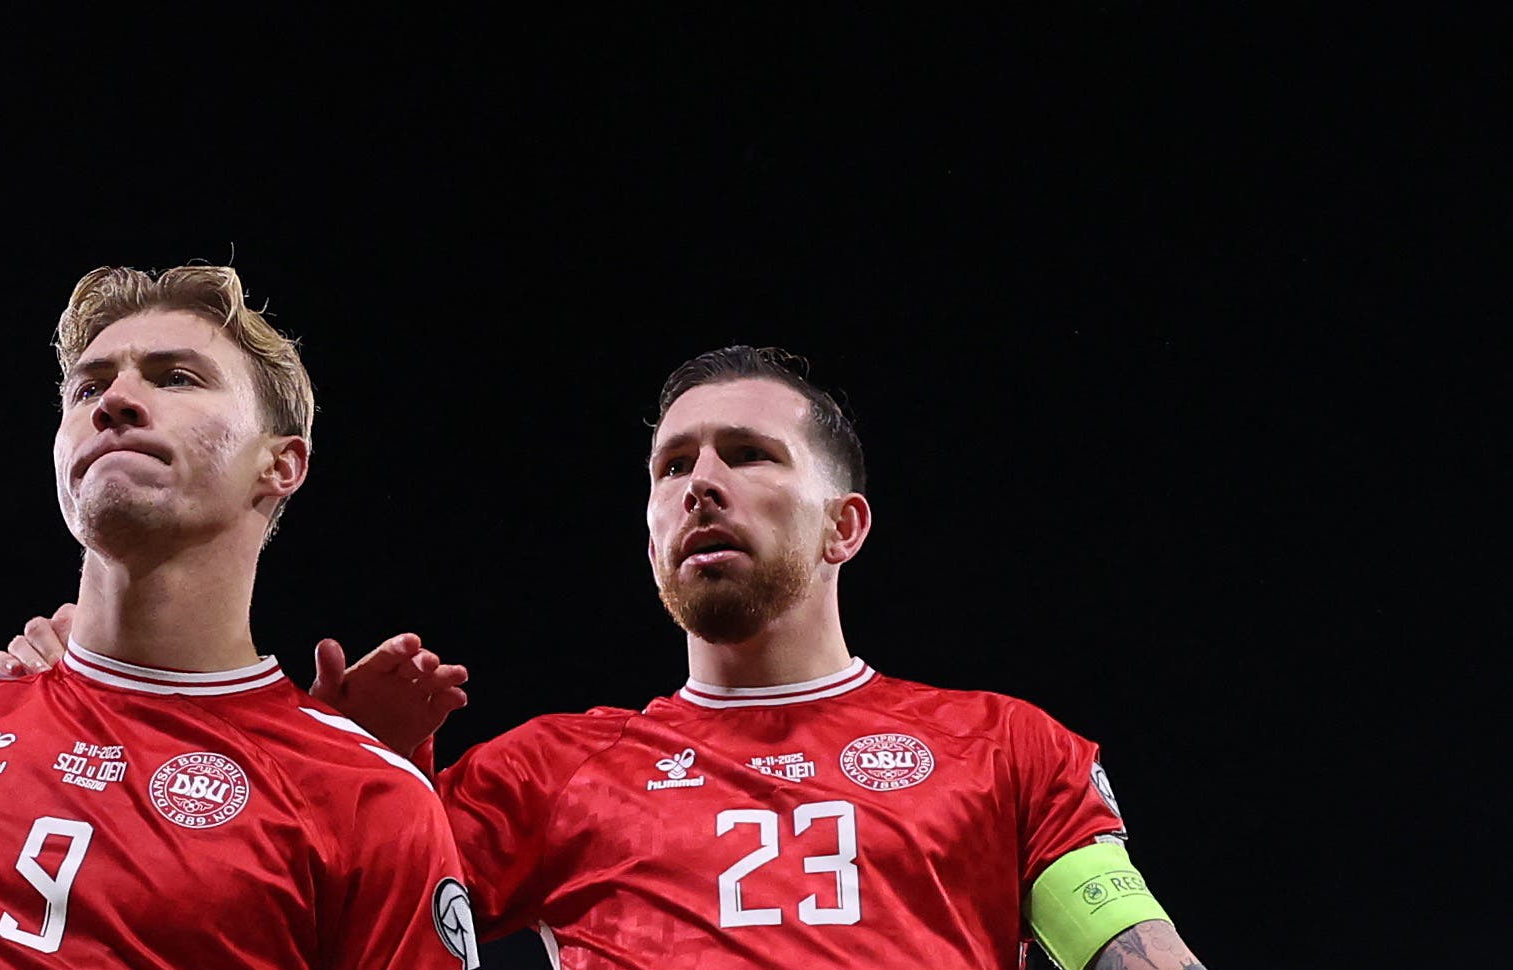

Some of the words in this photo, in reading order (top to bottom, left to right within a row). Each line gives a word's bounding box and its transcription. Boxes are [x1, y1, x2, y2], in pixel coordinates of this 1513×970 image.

[73, 741, 124, 759] 18-11-2025
[860, 751, 915, 769] DBU
[53, 753, 87, 775] SCO
[96, 761, 128, 782] DEN
[785, 760, 816, 779] DEN
[911, 750, 930, 780] UNION
[62, 773, 108, 792] GLASGOW
[153, 765, 177, 808] DANSK
[169, 773, 230, 803] DBU
[647, 775, 705, 791] hummel
[212, 788, 246, 822] UNION
[167, 809, 206, 826] 1889
[715, 800, 861, 928] 23
